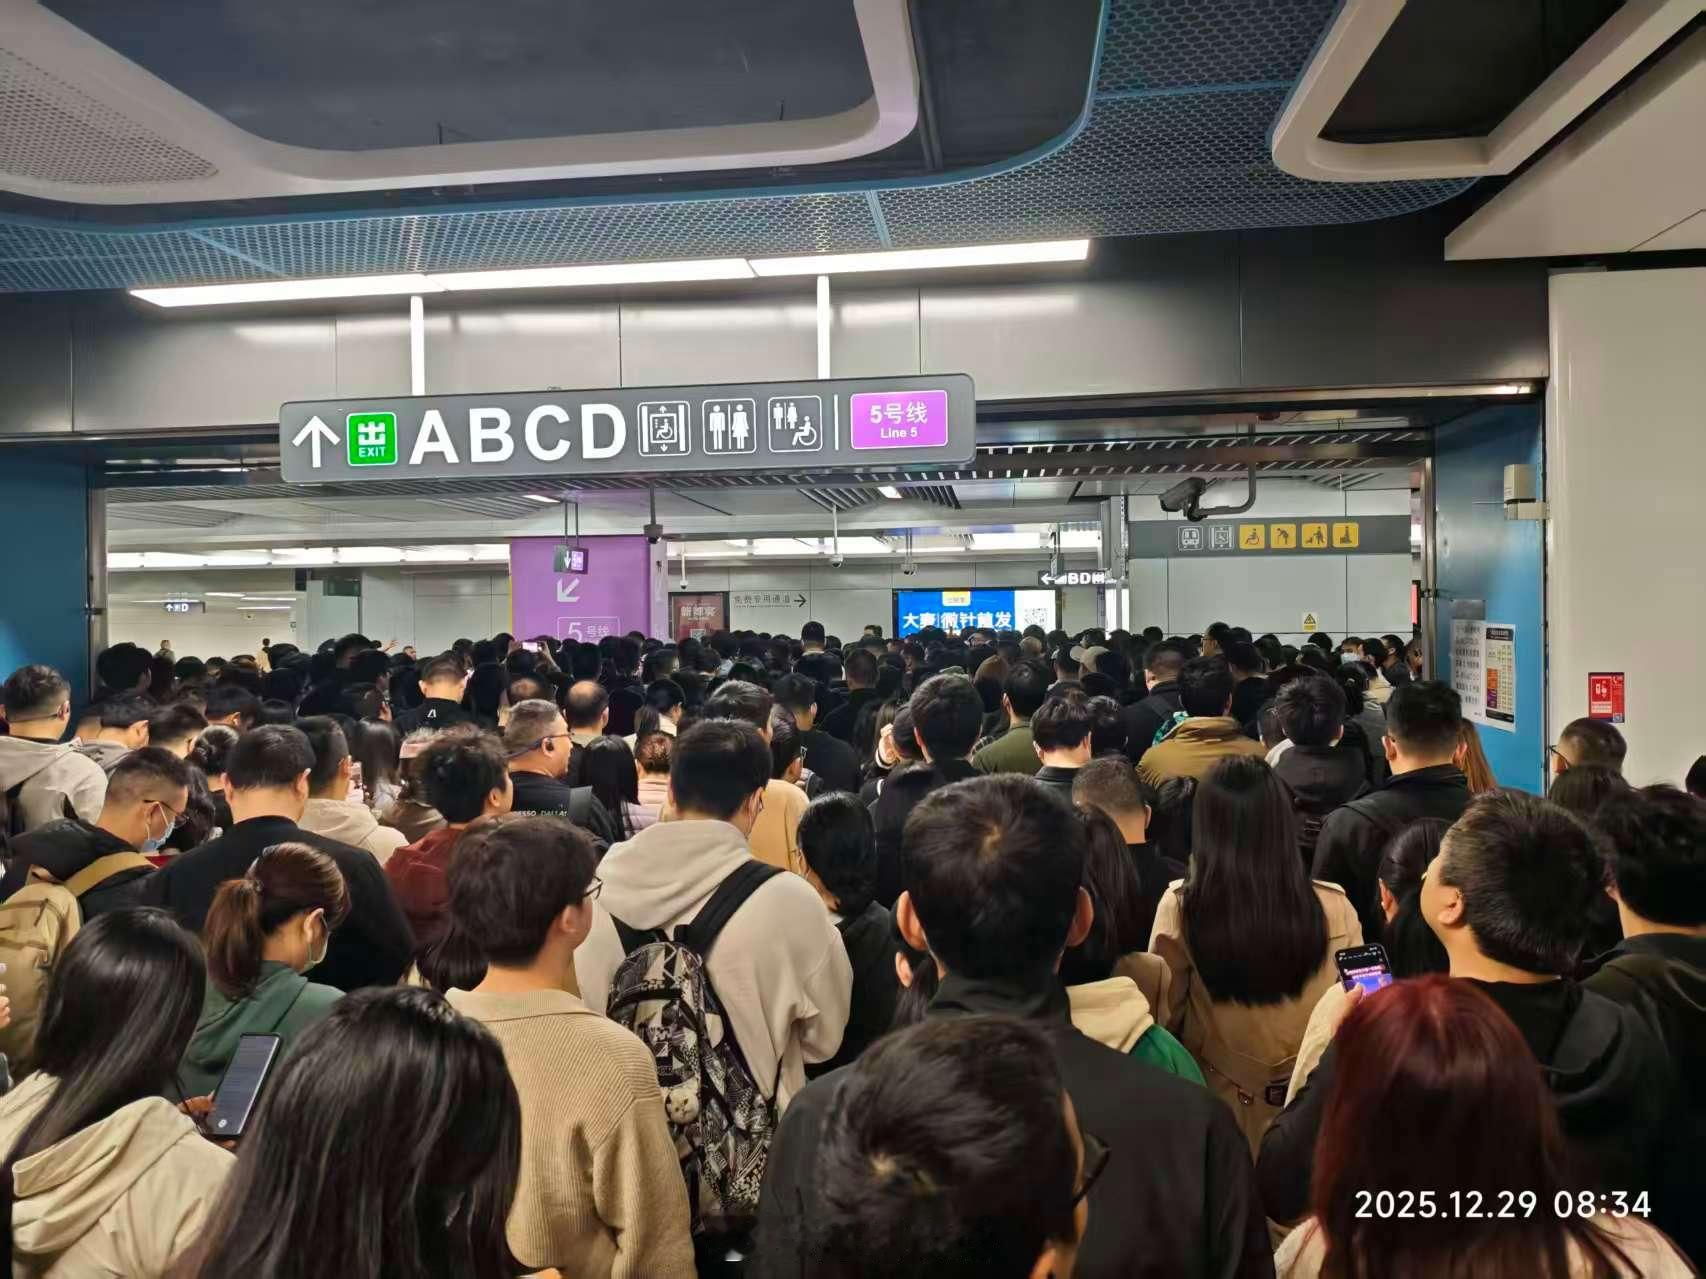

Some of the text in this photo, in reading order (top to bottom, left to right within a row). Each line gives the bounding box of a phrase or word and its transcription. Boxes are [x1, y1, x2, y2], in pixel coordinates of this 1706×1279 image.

[870, 401, 928, 424] 5号线
[880, 427, 918, 439] Line 5
[358, 446, 386, 458] EXIT
